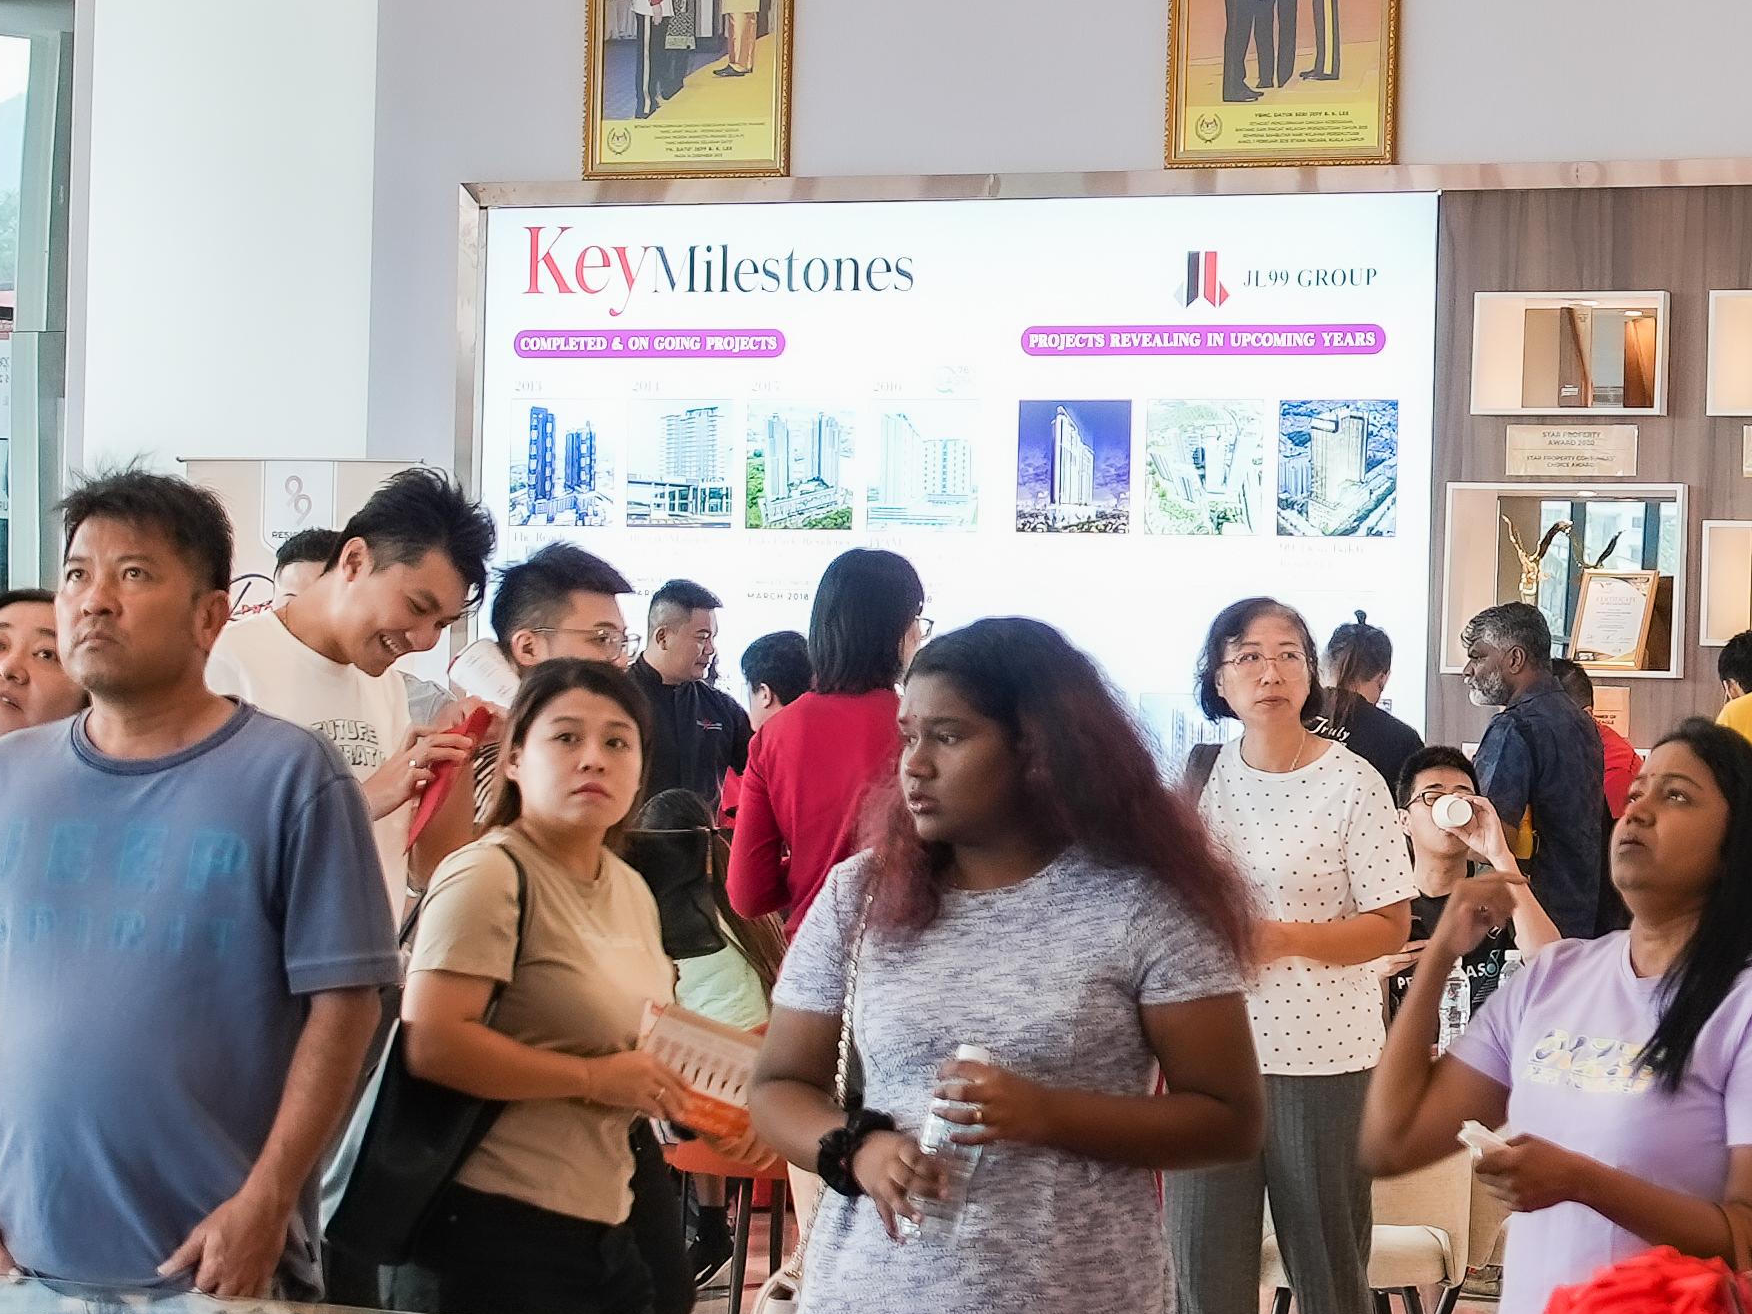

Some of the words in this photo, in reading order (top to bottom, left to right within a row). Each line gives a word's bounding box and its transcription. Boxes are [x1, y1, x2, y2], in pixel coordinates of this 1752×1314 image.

[1243, 269, 1289, 287] JL99
[1297, 268, 1377, 287] GROUP
[520, 336, 608, 352] COMPLETED
[611, 336, 624, 351] &
[628, 336, 650, 351] ON
[653, 336, 701, 352] GOING
[705, 335, 778, 353] PROJECTS
[1029, 333, 1105, 351] PROJECTS
[1110, 333, 1201, 349] REVEALING
[1207, 333, 1225, 347] IN
[1230, 332, 1316, 348] UPCOMING
[1321, 331, 1376, 347] YEARS
[1542, 431, 1560, 439] STAR
[1563, 431, 1601, 439] PROPERTY
[1307, 715, 1351, 742] Truly
